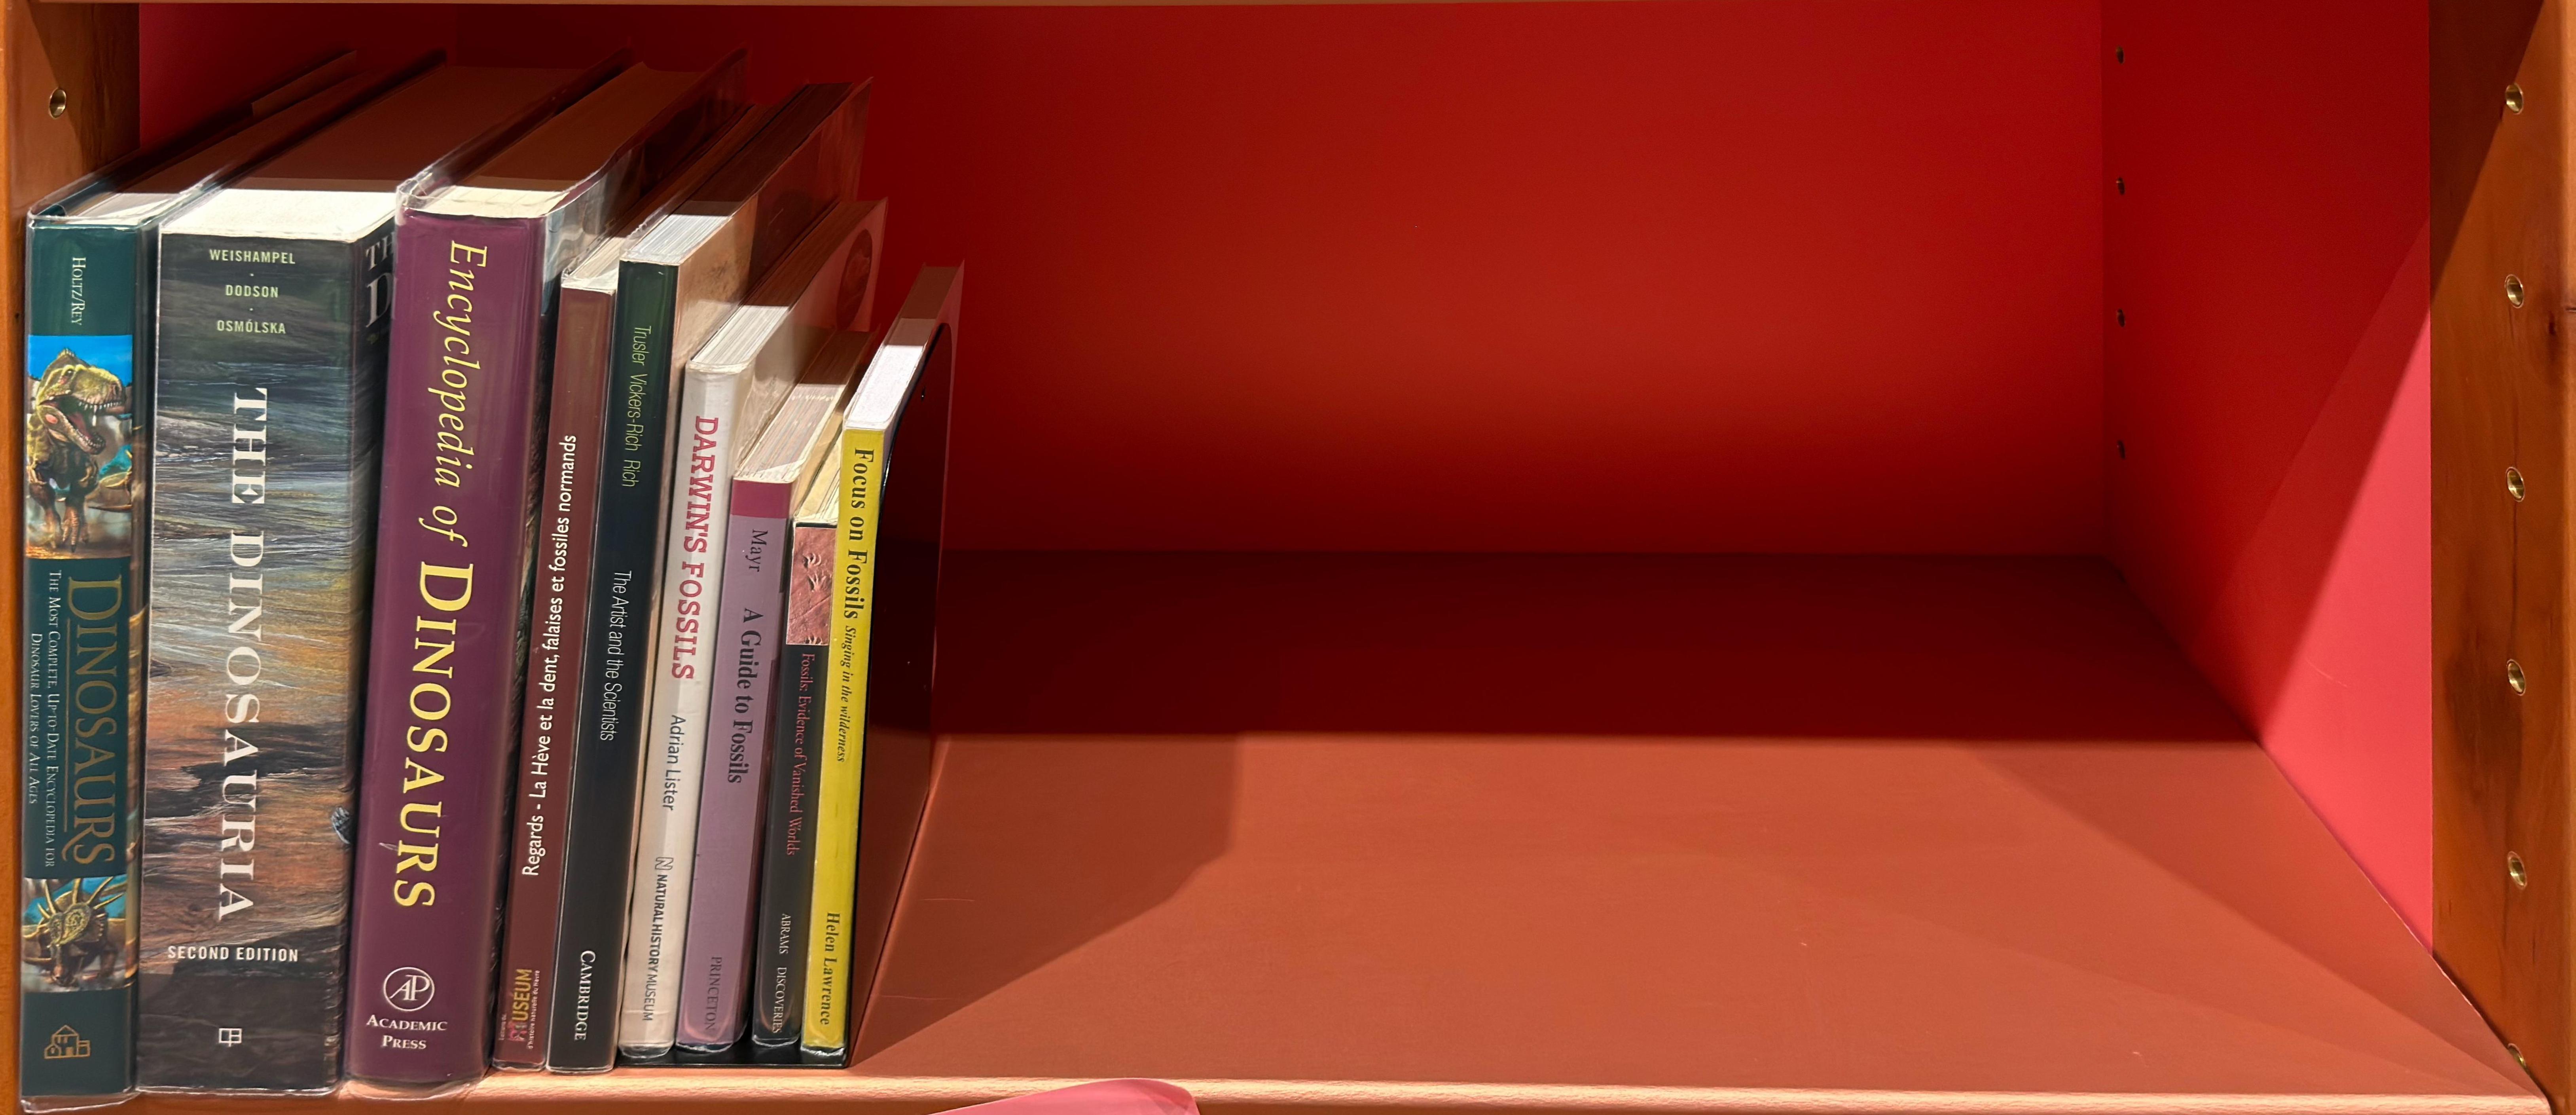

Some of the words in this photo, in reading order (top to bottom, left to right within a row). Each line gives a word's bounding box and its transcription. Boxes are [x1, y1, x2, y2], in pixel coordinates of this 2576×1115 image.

[209, 249, 296, 264] WEISHAMPEL
[226, 285, 279, 298] DODSON
[217, 320, 286, 334] OSMÓLSKA
[631, 325, 652, 366] Trusler
[428, 240, 488, 488] Encyclopedia
[626, 373, 648, 451] Vickers-Rich
[232, 388, 267, 504] THE
[558, 434, 577, 512] normands
[622, 458, 641, 487] Rich
[683, 415, 719, 553] DARWIN'S
[851, 448, 874, 509] Focus
[419, 505, 468, 548] of
[548, 517, 570, 571] fossiles
[849, 516, 865, 541] on
[746, 529, 768, 573] Mayr
[49, 570, 62, 592] THE
[552, 576, 564, 592] et
[613, 570, 632, 594] The
[844, 549, 868, 619] Fossils
[48, 597, 61, 628] MOST
[542, 597, 563, 652] falaises
[609, 595, 630, 628] Artist
[671, 561, 704, 680] FOSSILS
[743, 607, 764, 623] A
[30, 633, 43, 689] DINOSAUR
[608, 631, 626, 655] and
[736, 630, 762, 689] Guide
[840, 625, 857, 669] Singing
[538, 652, 560, 692] dent,
[605, 656, 624, 679] the
[800, 653, 815, 691] Fossils:
[843, 671, 855, 683] in
[537, 697, 554, 709] la
[600, 682, 623, 741] Scientists
[734, 694, 755, 714] to
[841, 686, 852, 703] the
[61, 575, 123, 865] DINOSAURS
[219, 530, 264, 922] DINOSAURIA
[394, 561, 474, 907] DINOSAURS
[540, 714, 553, 730] et
[666, 715, 686, 765] Adrian
[794, 696, 812, 744] Evidence
[836, 705, 852, 762] wilderness
[531, 736, 551, 775] Hève
[728, 720, 753, 783] Fossils
[794, 747, 807, 760] of
[529, 781, 547, 798] La
[662, 769, 681, 811] Lister
[789, 762, 806, 813] Vanished
[521, 815, 546, 876] Regards
[786, 817, 803, 856] Worlds
[654, 874, 668, 922] NATURAL
[647, 924, 662, 971] HISTORY
[779, 912, 791, 954] ABRAMS
[825, 912, 840, 952] Helen
[168, 946, 229, 960] SECOND
[236, 948, 299, 963] EDITION
[574, 950, 596, 1041] CAMBRIDGE
[642, 973, 658, 1021] MUSEUM
[704, 956, 722, 1031] PRINCETON
[772, 967, 787, 1034] DISCOVERIES
[820, 957, 838, 1025] Lawrence
[366, 1014, 448, 1031] ACADEMIC
[381, 1035, 427, 1049] PRESS
